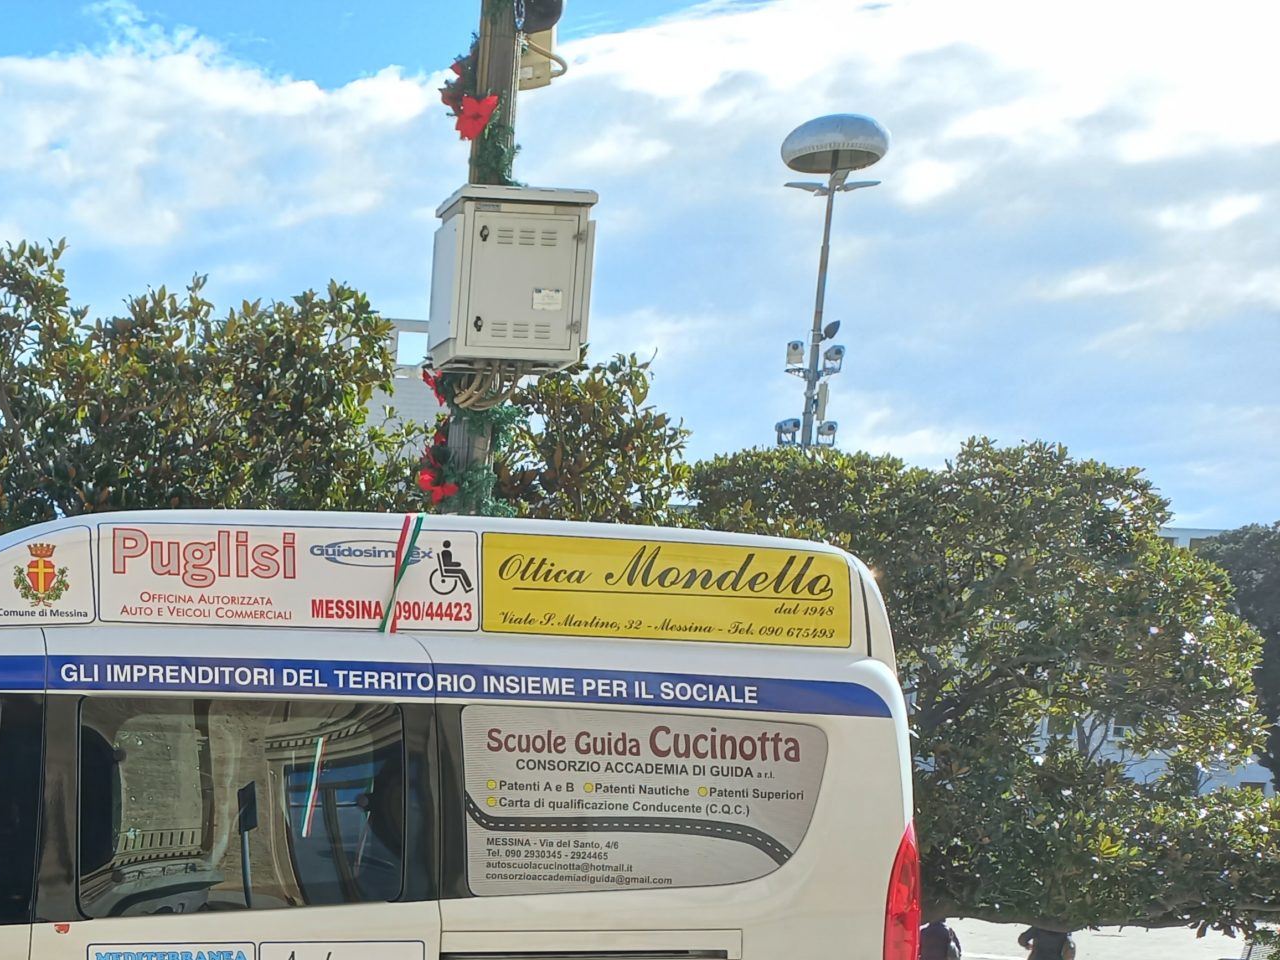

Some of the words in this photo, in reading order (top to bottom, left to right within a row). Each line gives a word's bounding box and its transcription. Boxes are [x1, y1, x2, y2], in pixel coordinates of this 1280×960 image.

[112, 527, 296, 588] Puglisi
[310, 544, 433, 560] Guidosimex
[499, 553, 591, 584] Ottica
[605, 545, 833, 600] Mondello
[140, 592, 193, 605] OFFICINA
[198, 593, 272, 606] AUTORIZZATA
[39, 608, 48, 617] di
[50, 609, 88, 618] Messina
[120, 604, 153, 617] AUTO
[157, 607, 163, 616] E
[167, 606, 210, 618] VEICOLI
[215, 607, 292, 620] COMMERCIALI
[311, 599, 384, 620] MESSINA
[395, 601, 472, 621] 090/44423
[774, 602, 799, 615] dal
[803, 606, 834, 616] 1948
[499, 610, 538, 626] Viale
[539, 613, 555, 626] S.
[556, 614, 621, 630] Martino,
[624, 619, 642, 630] 32
[654, 619, 714, 633] Messina
[728, 622, 753, 635] Tel.
[759, 626, 783, 637] 090
[787, 627, 835, 639] 675493
[61, 663, 99, 682] GLI
[107, 664, 275, 686] IMPRENDITORI
[283, 668, 327, 688] DEL
[334, 669, 476, 693] TERRITORIO
[483, 676, 575, 695] INSIEME
[582, 678, 627, 698] PER
[634, 681, 654, 699] IL
[660, 681, 758, 704] SOCIALE
[486, 728, 566, 754] Scuole
[575, 731, 641, 756] Guida
[649, 725, 800, 762] Cucinotta
[516, 759, 601, 773] CONSORZIO
[604, 762, 689, 776] ACCADEMIA
[692, 764, 706, 776] DI
[710, 765, 754, 778] GUIDA
[499, 780, 541, 793] Patenti
[543, 782, 553, 792] A
[555, 784, 562, 793] e
[566, 782, 574, 792] B
[595, 783, 635, 795] Patenti
[639, 785, 690, 797] Nautiche
[709, 787, 749, 799] Patenti
[752, 789, 804, 802] Superiori
[499, 797, 531, 810] Carta
[534, 798, 545, 810] di
[548, 799, 629, 814] qualificazione
[632, 801, 702, 814] Conducente
[705, 803, 750, 817] (C.Q.C.)
[486, 837, 531, 847] MESSINA
[539, 838, 554, 848] Via
[557, 839, 570, 849] del
[573, 839, 603, 851] Santo,
[605, 840, 619, 850] 4/6
[486, 849, 503, 858] Tel.
[505, 850, 522, 859] 090
[523, 850, 562, 860] 2930345
[570, 851, 608, 861] 2924465
[485, 860, 633, 873] autoscuolacucinotta@hotmail.it
